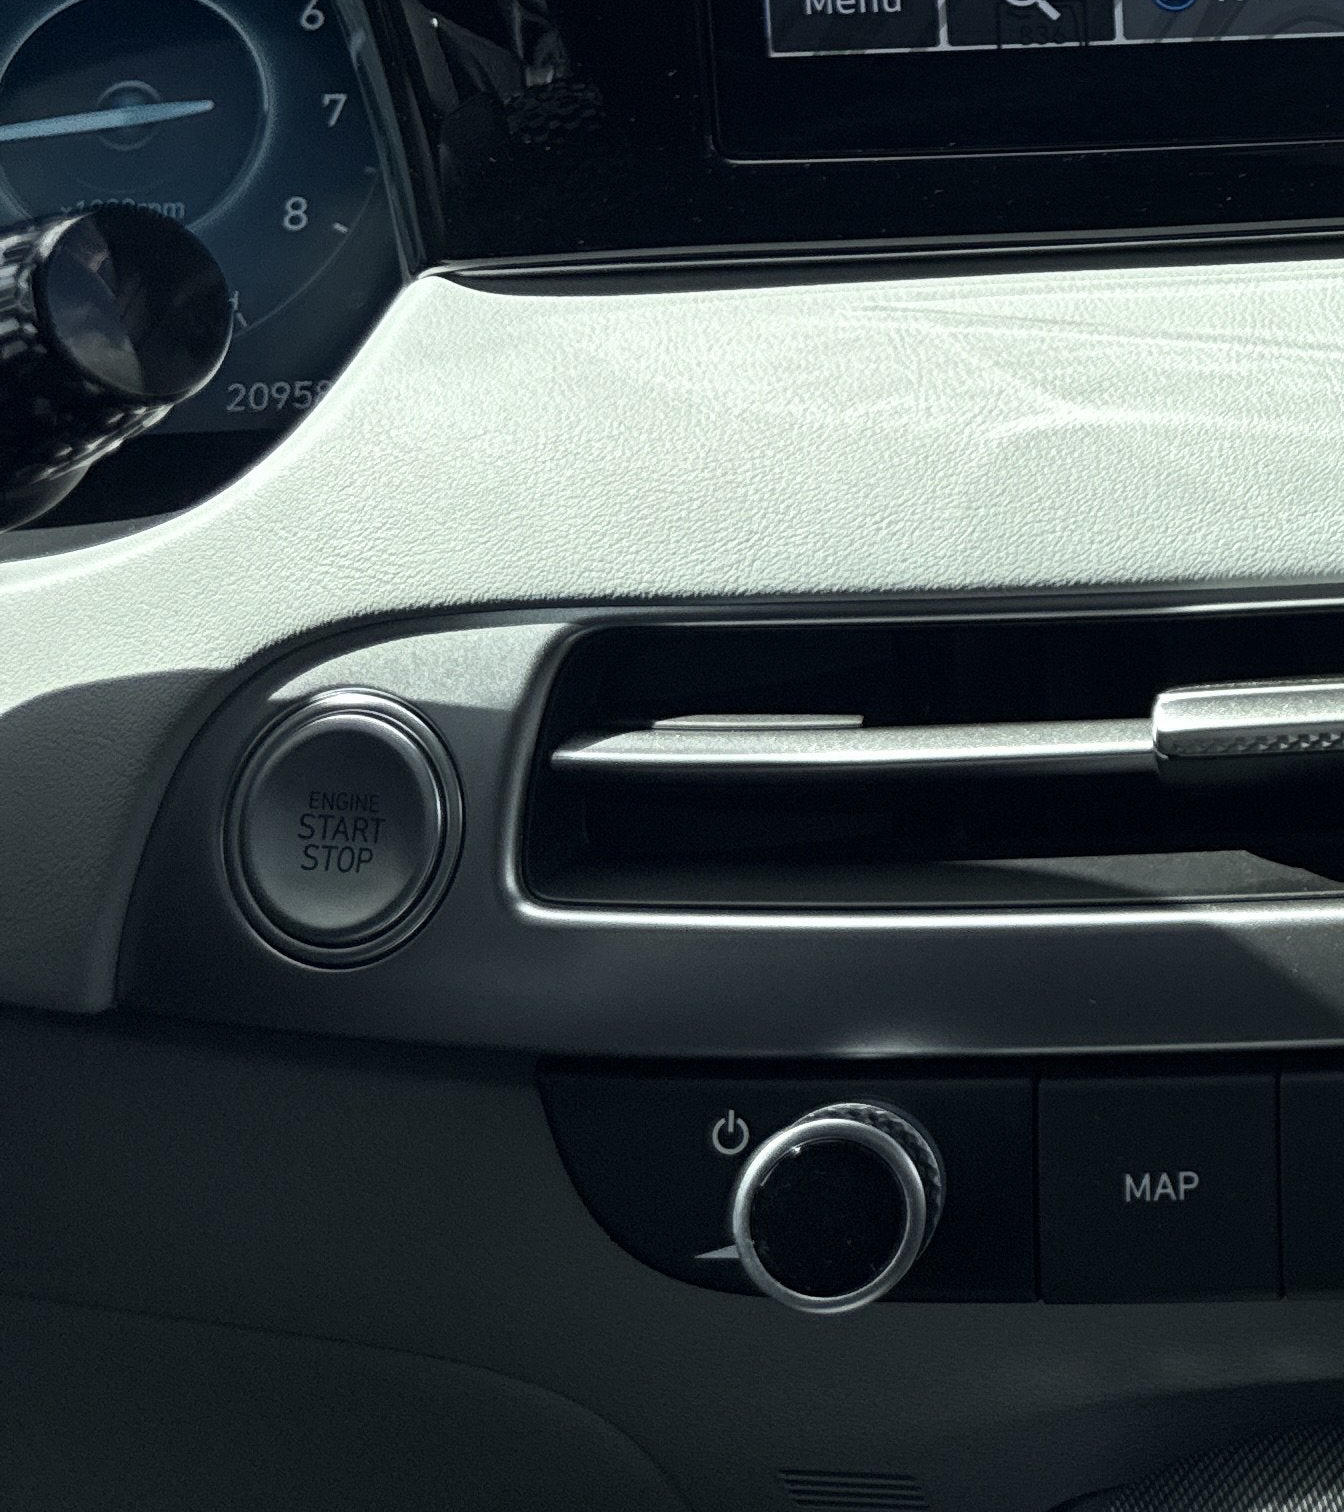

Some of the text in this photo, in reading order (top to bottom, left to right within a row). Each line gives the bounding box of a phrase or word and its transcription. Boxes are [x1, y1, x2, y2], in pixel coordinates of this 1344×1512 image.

[321, 92, 348, 126] 7
[282, 196, 309, 231] 8
[309, 791, 381, 813] ENGINE
[297, 813, 387, 845] START
[300, 844, 374, 874] STOP
[1124, 1171, 1200, 1203] MAP
